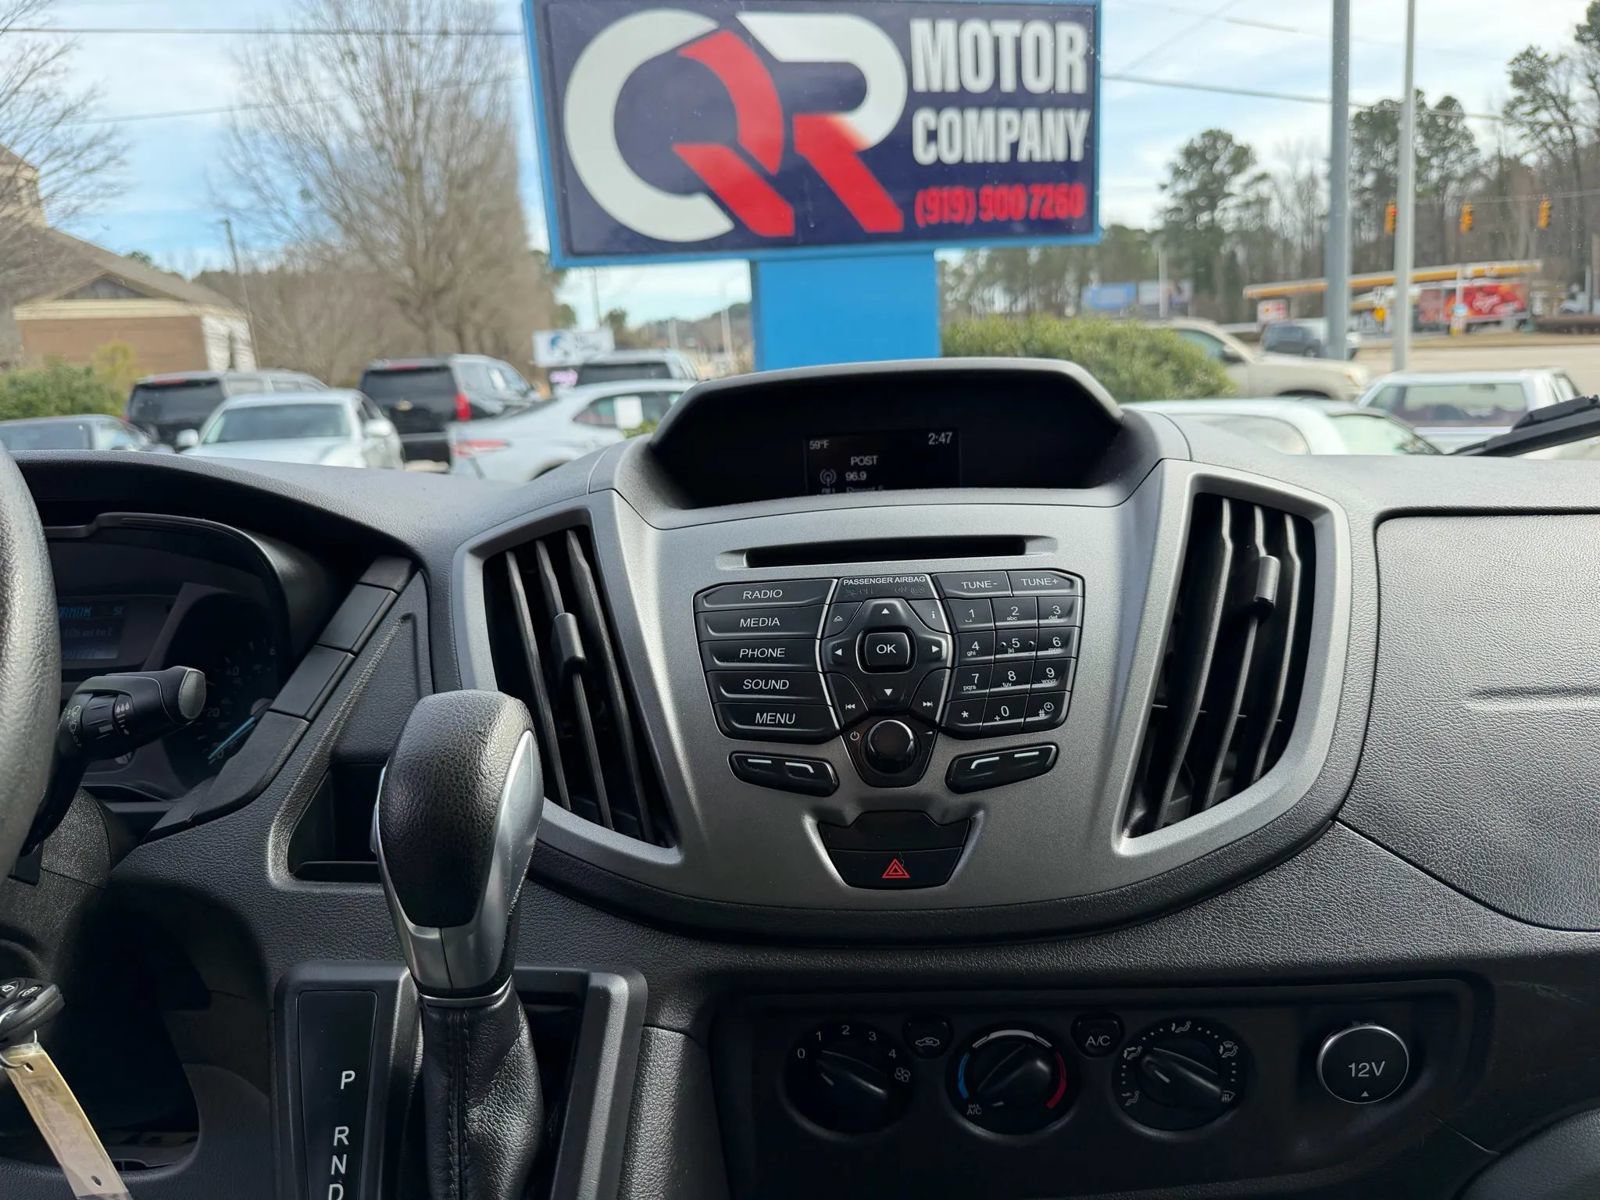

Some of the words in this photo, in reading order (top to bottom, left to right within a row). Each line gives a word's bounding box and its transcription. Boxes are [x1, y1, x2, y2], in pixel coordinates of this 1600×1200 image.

[910, 18, 1087, 94] MOTOR
[912, 106, 1091, 165] COMPANY
[915, 185, 976, 228] (919)
[978, 184, 1027, 222] 900
[928, 431, 953, 446] 2:47
[850, 455, 879, 467] POST
[845, 470, 868, 481] 96.9
[843, 577, 894, 586] PASSENGER
[894, 575, 926, 583] AIRBAG
[743, 589, 783, 600] RADIO
[968, 608, 976, 618] 1
[1010, 606, 1020, 616] 2
[1052, 604, 1061, 615] 3
[739, 617, 781, 628] MEDIA
[971, 641, 980, 651] 4
[1011, 637, 1020, 648] 5
[1052, 636, 1061, 647] 6
[739, 647, 786, 658] PHONE
[876, 643, 897, 655] OK
[1007, 670, 1017, 682] 8
[1046, 667, 1055, 678] 9
[971, 673, 980, 684] 7
[743, 679, 789, 690] SOUND
[1000, 705, 1010, 717] 0
[755, 712, 796, 724] MENU
[815, 1031, 823, 1041] 1
[841, 1025, 851, 1036] 2
[868, 1031, 877, 1041] 3
[1085, 1034, 1111, 1047] A/C
[797, 1048, 806, 1059] 0
[888, 1048, 897, 1059] 4
[1348, 1060, 1386, 1078] 12V
[340, 1070, 356, 1090] P
[333, 1125, 350, 1147] R
[331, 1153, 347, 1176] N
[328, 1183, 344, 1200] D
